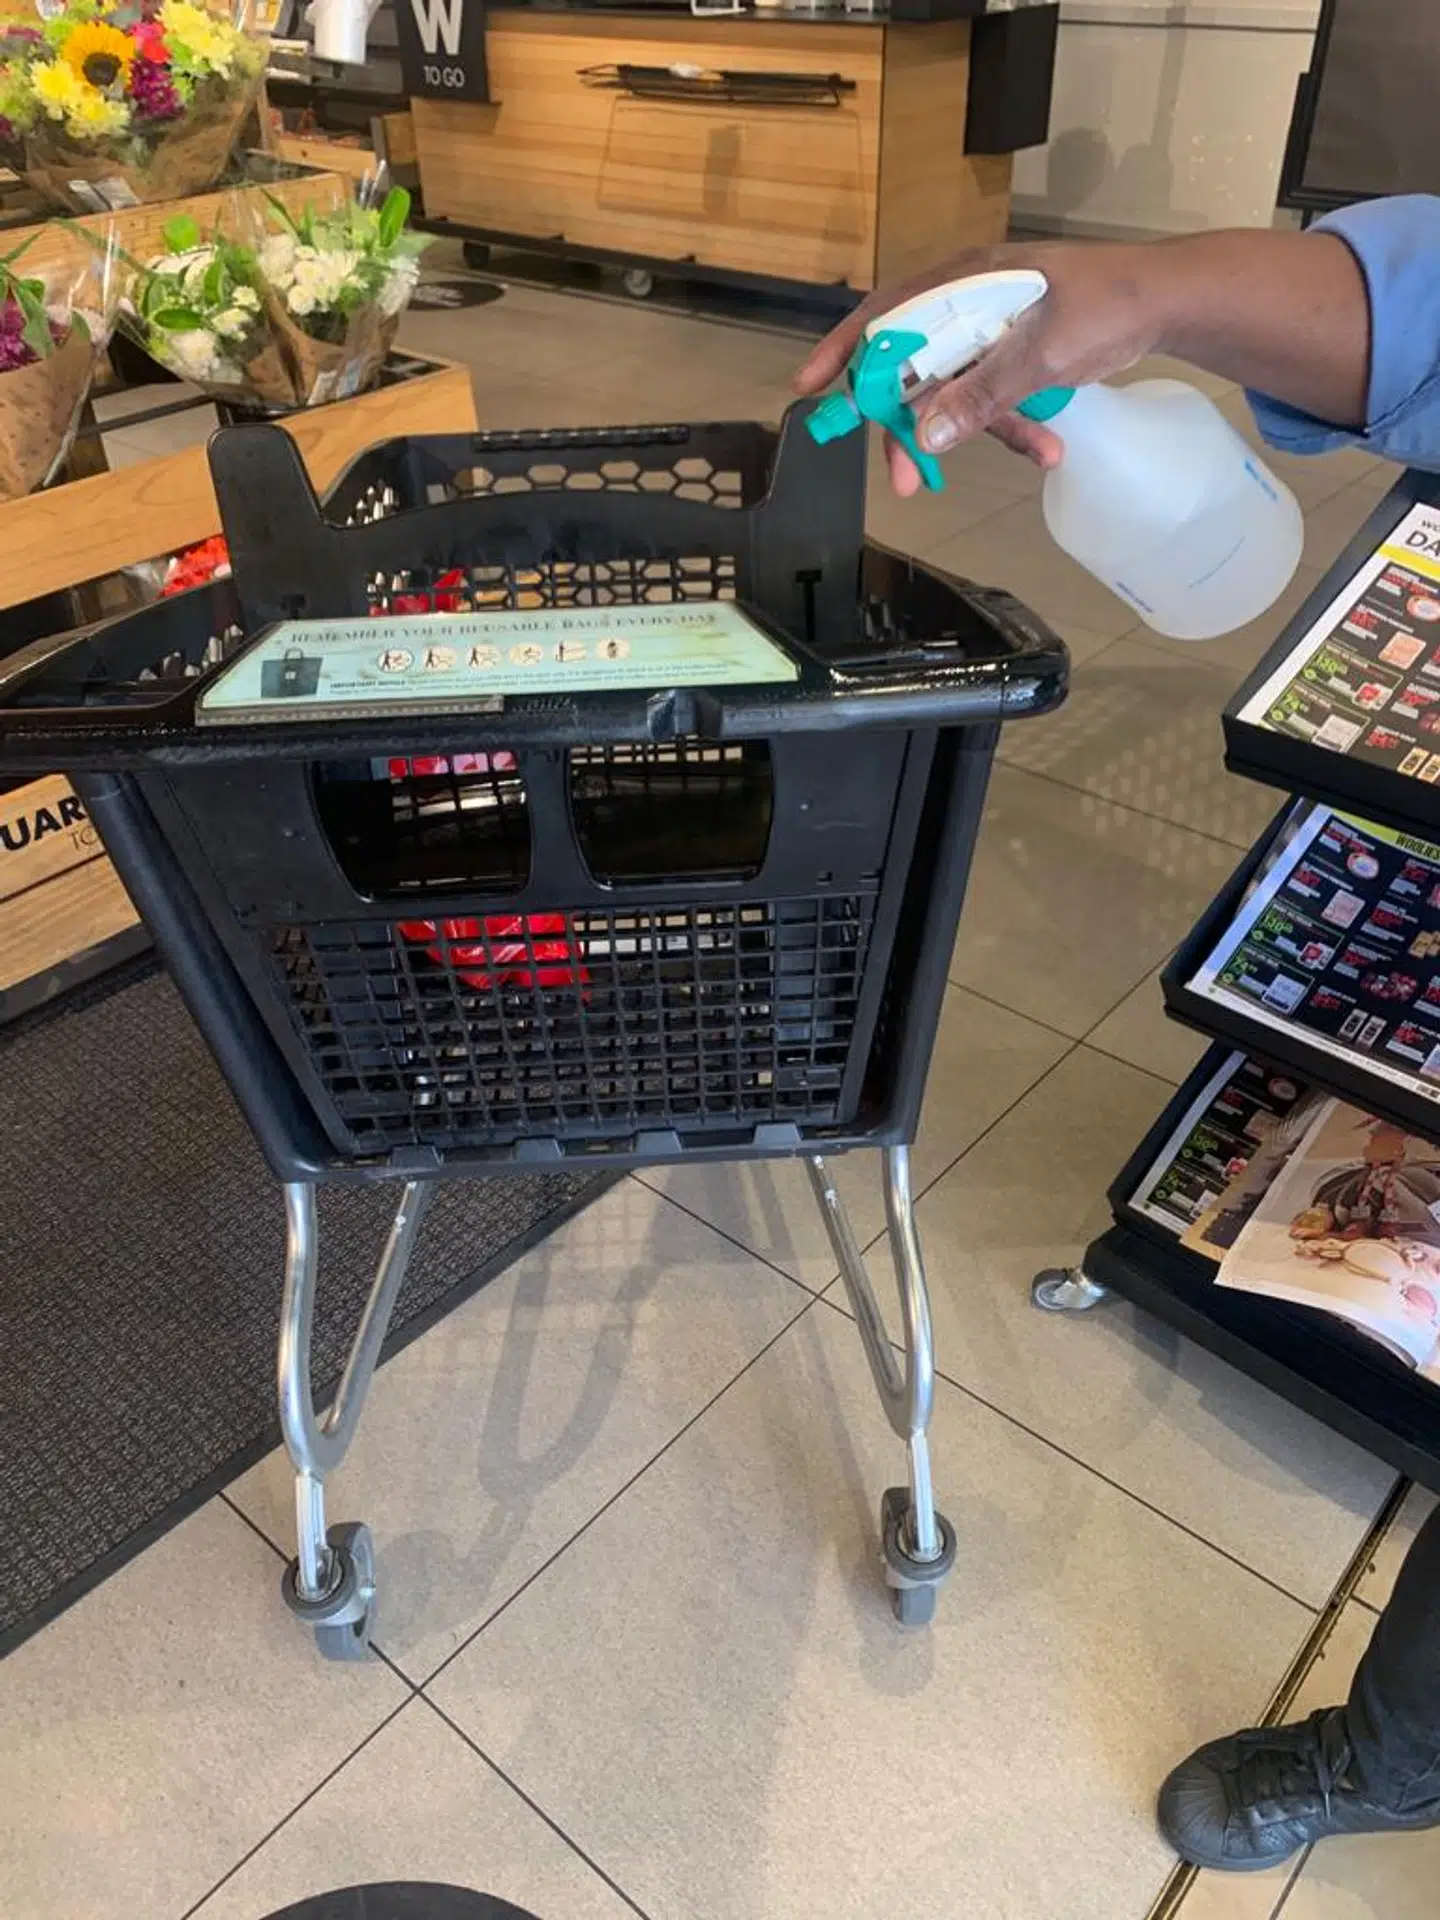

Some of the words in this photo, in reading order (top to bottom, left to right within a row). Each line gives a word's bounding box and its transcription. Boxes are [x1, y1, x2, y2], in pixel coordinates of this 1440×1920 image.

[410, 0, 464, 55] W
[423, 65, 441, 86] TO
[442, 66, 466, 88] GO
[291, 626, 395, 643] REMEMBER
[401, 623, 452, 638] YOUR
[458, 617, 556, 635] REUSABLE
